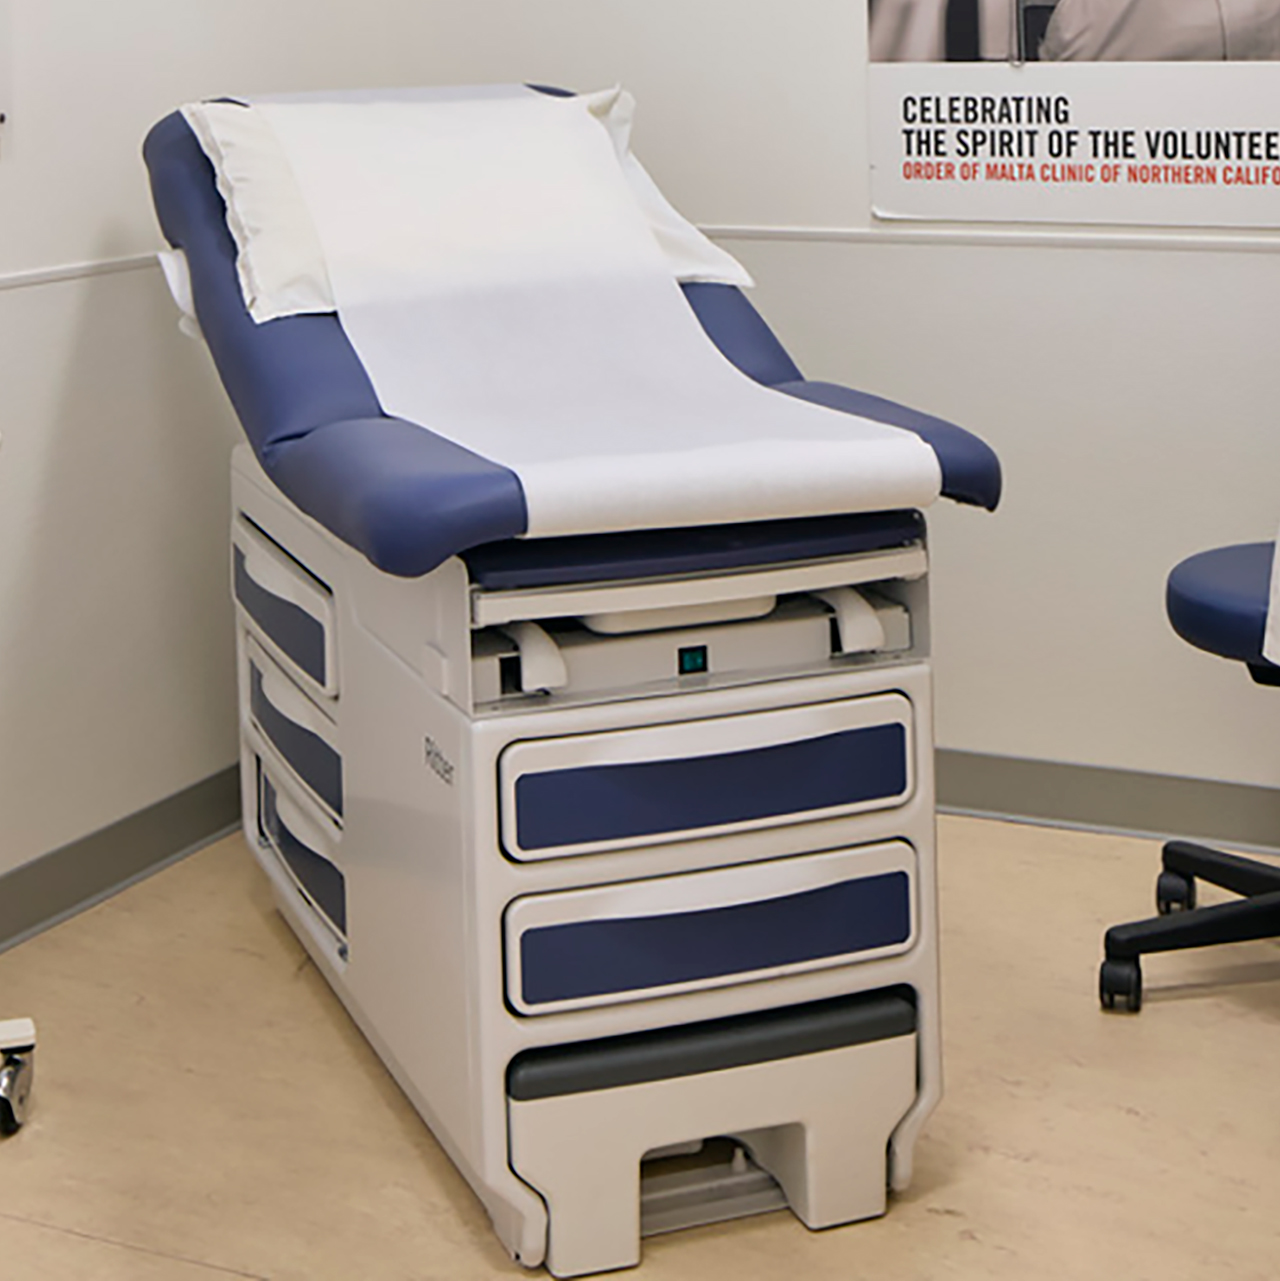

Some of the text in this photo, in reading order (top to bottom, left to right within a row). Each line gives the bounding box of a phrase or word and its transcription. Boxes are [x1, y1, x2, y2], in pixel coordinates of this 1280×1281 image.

[901, 95, 1070, 125] CELEBRATING
[901, 128, 948, 158] THE
[955, 128, 1039, 158] SPIRIT
[1047, 129, 1080, 159] OF
[1087, 130, 1137, 160] THE
[901, 161, 956, 181] ORDER
[959, 162, 980, 181] OF
[985, 162, 1036, 182] MALTA
[1039, 163, 1095, 183] CLINIC
[1100, 163, 1121, 184] OF
[1127, 164, 1217, 185] NORTHERN
